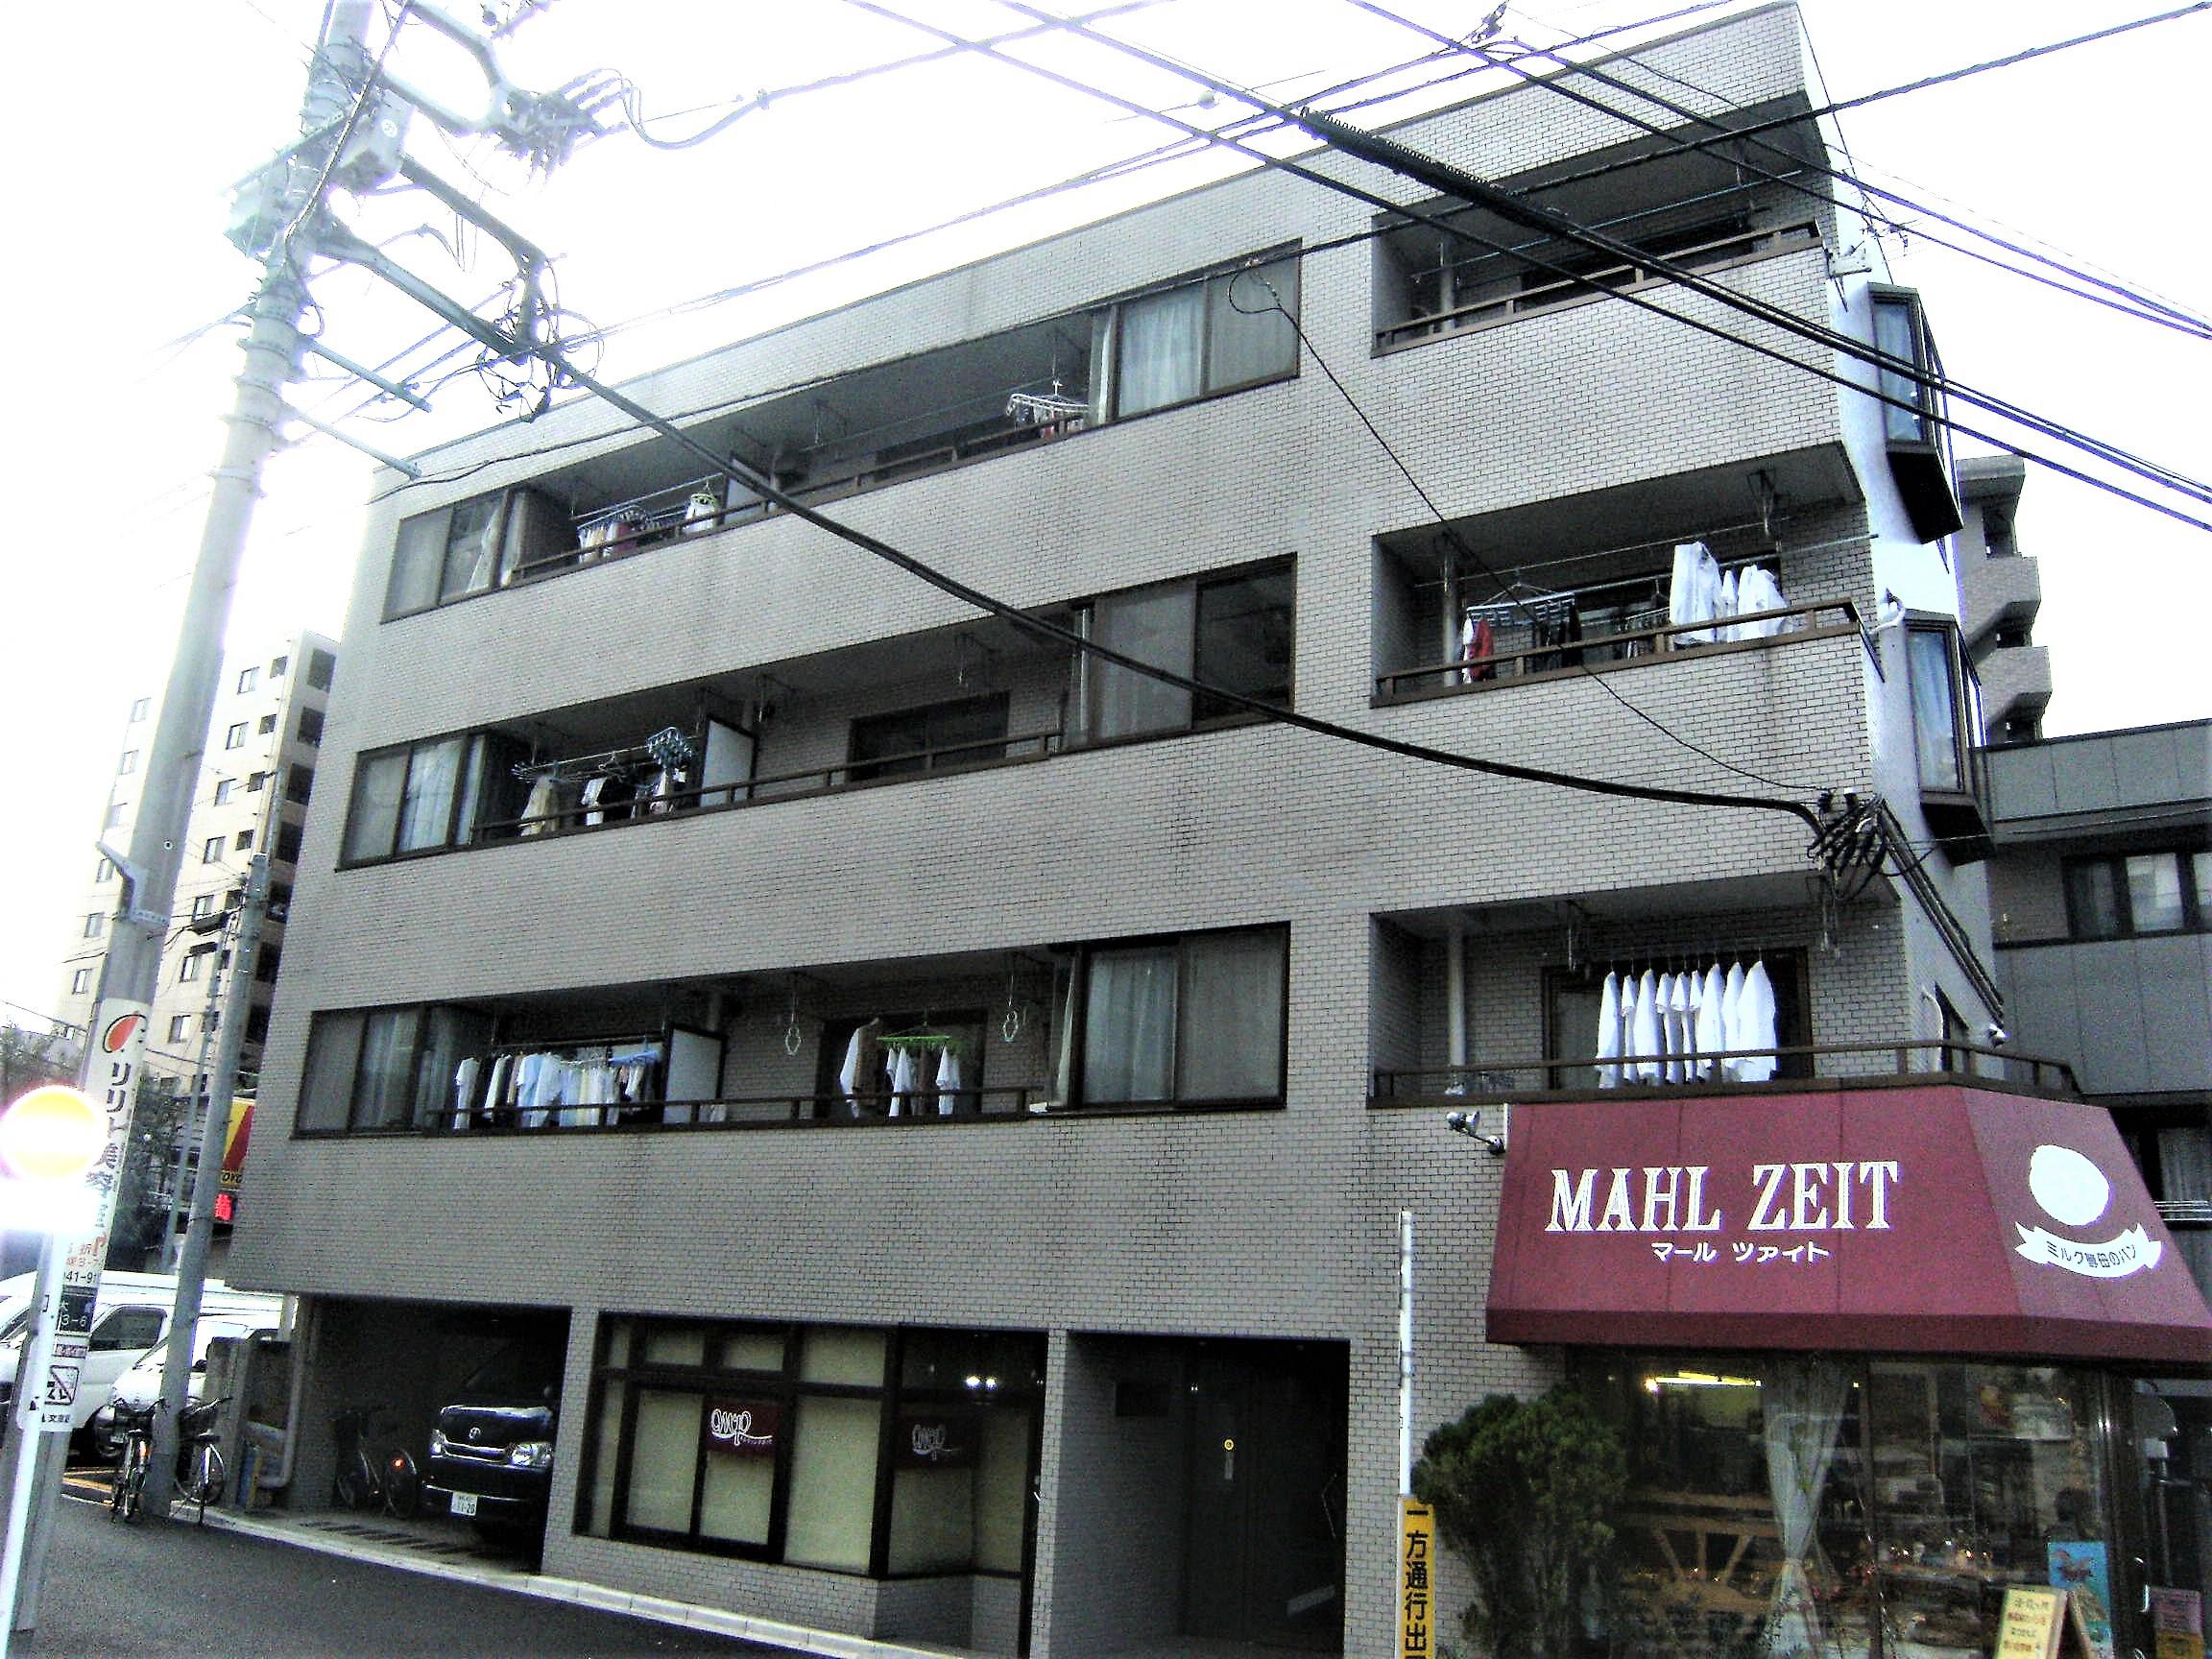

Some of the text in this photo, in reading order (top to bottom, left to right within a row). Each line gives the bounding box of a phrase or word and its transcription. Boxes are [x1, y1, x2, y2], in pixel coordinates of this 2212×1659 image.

[1544, 1160, 1899, 1232] MAHL ZEIT
[1650, 1242, 1717, 1262] マール
[1404, 1509, 1430, 1659] 一方通行出
